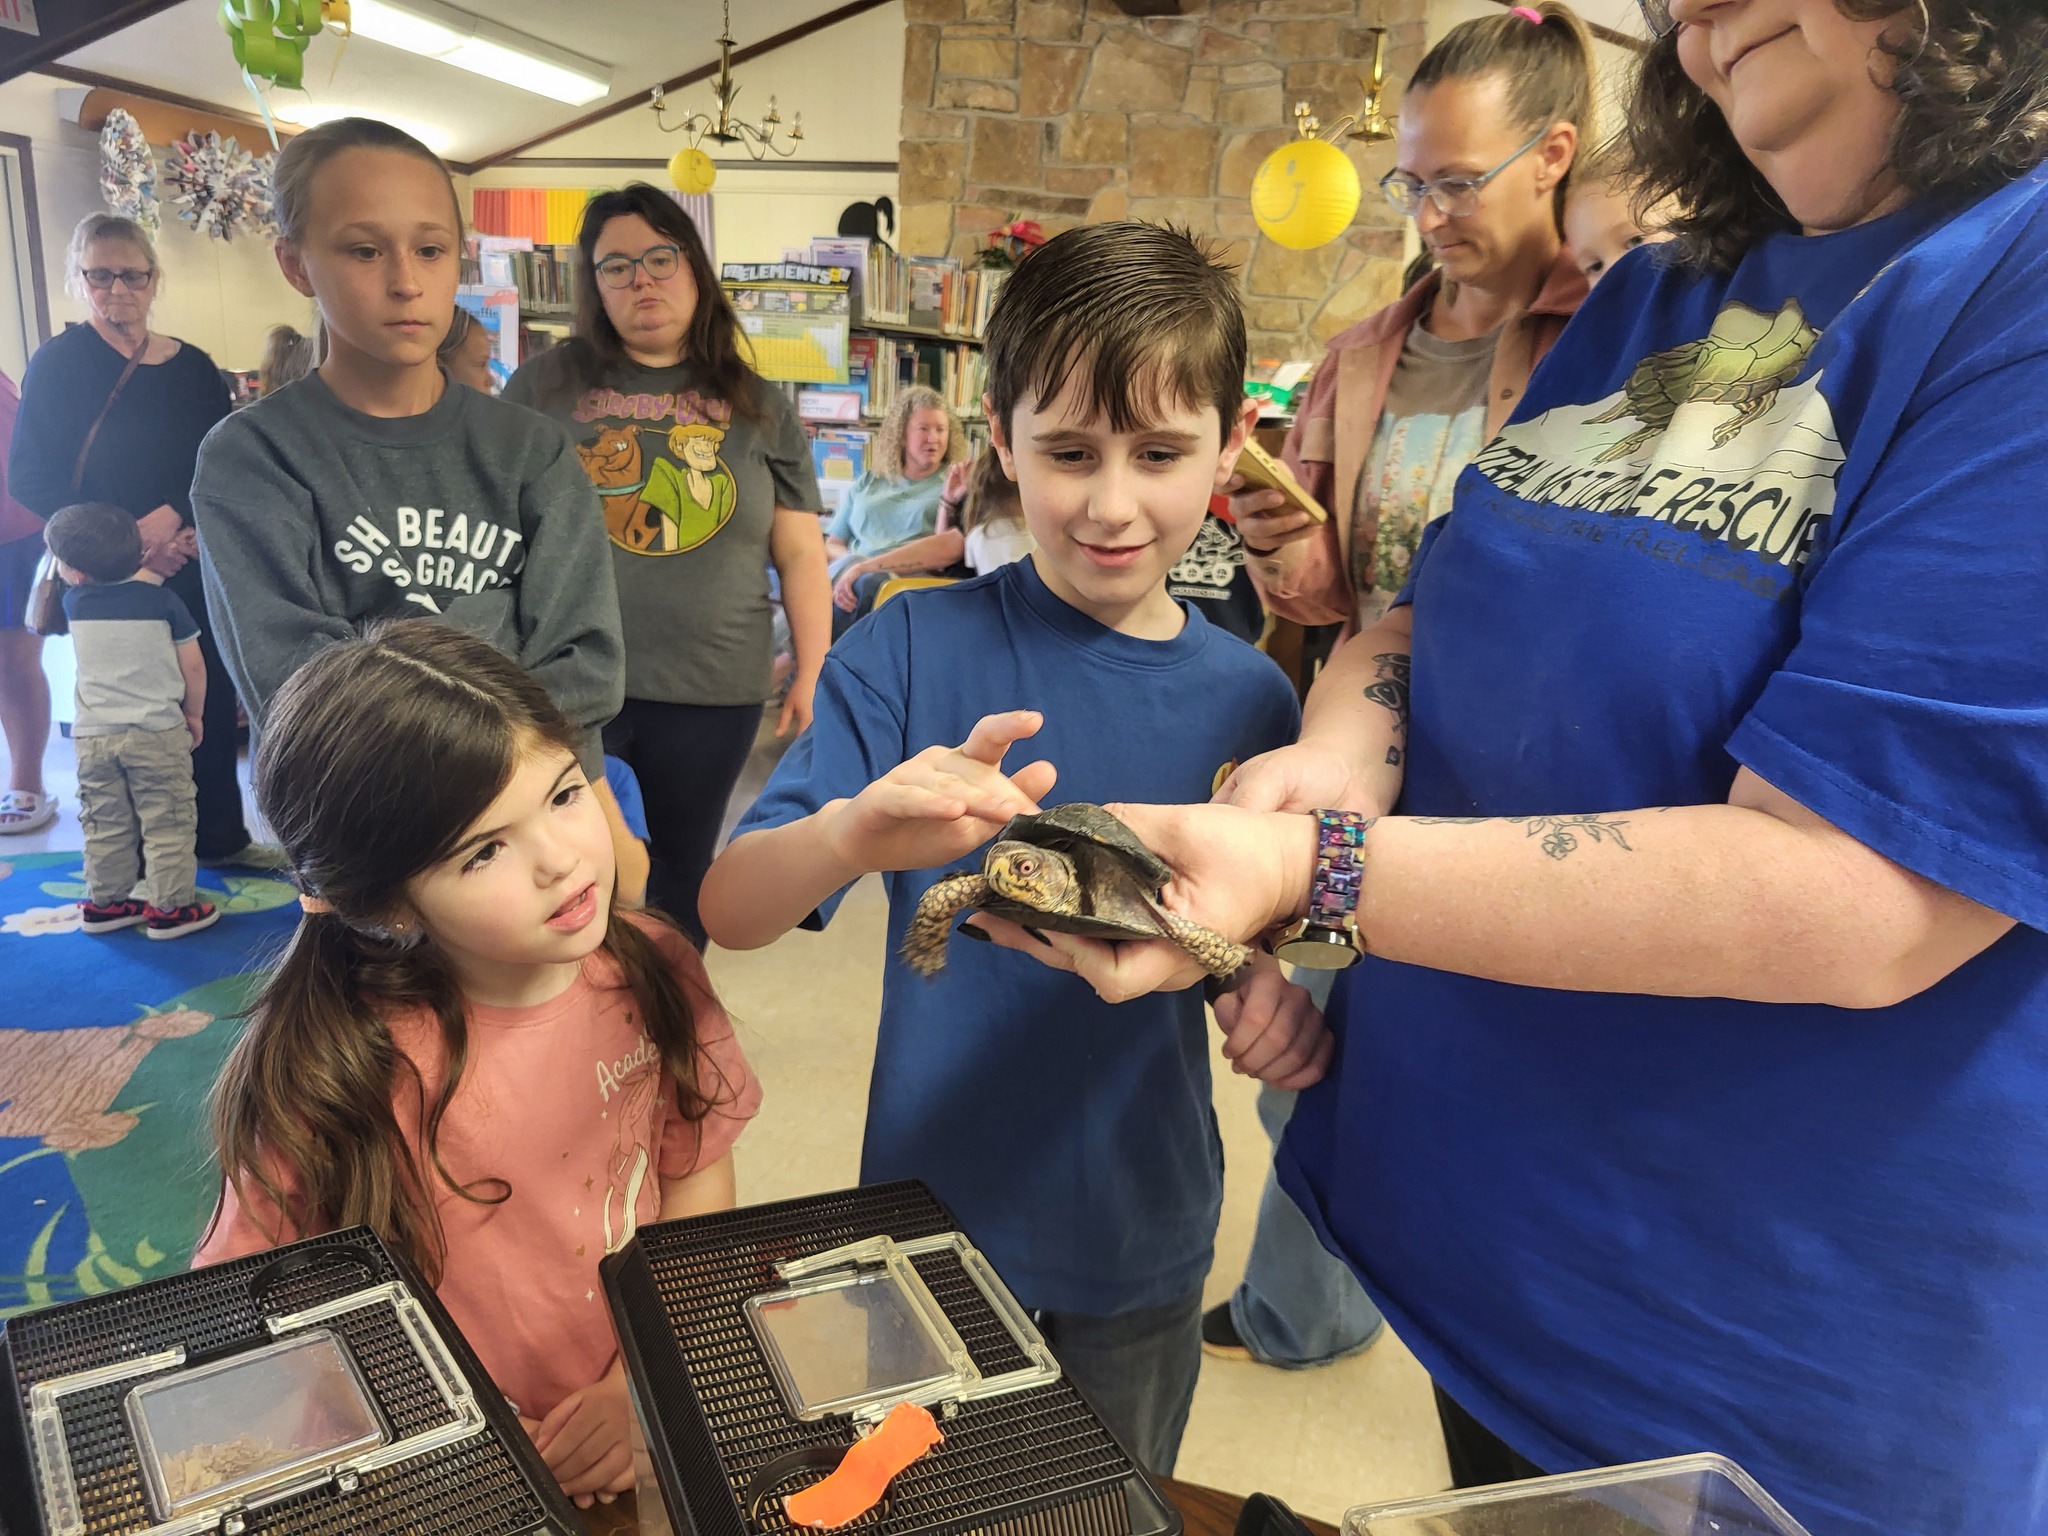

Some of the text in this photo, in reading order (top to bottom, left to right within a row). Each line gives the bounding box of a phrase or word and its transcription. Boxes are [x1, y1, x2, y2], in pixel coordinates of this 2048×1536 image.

[334, 506, 525, 575] SH BEAUT
[1651, 477, 1832, 568] RESCUE
[596, 1034, 660, 1104] Acade
